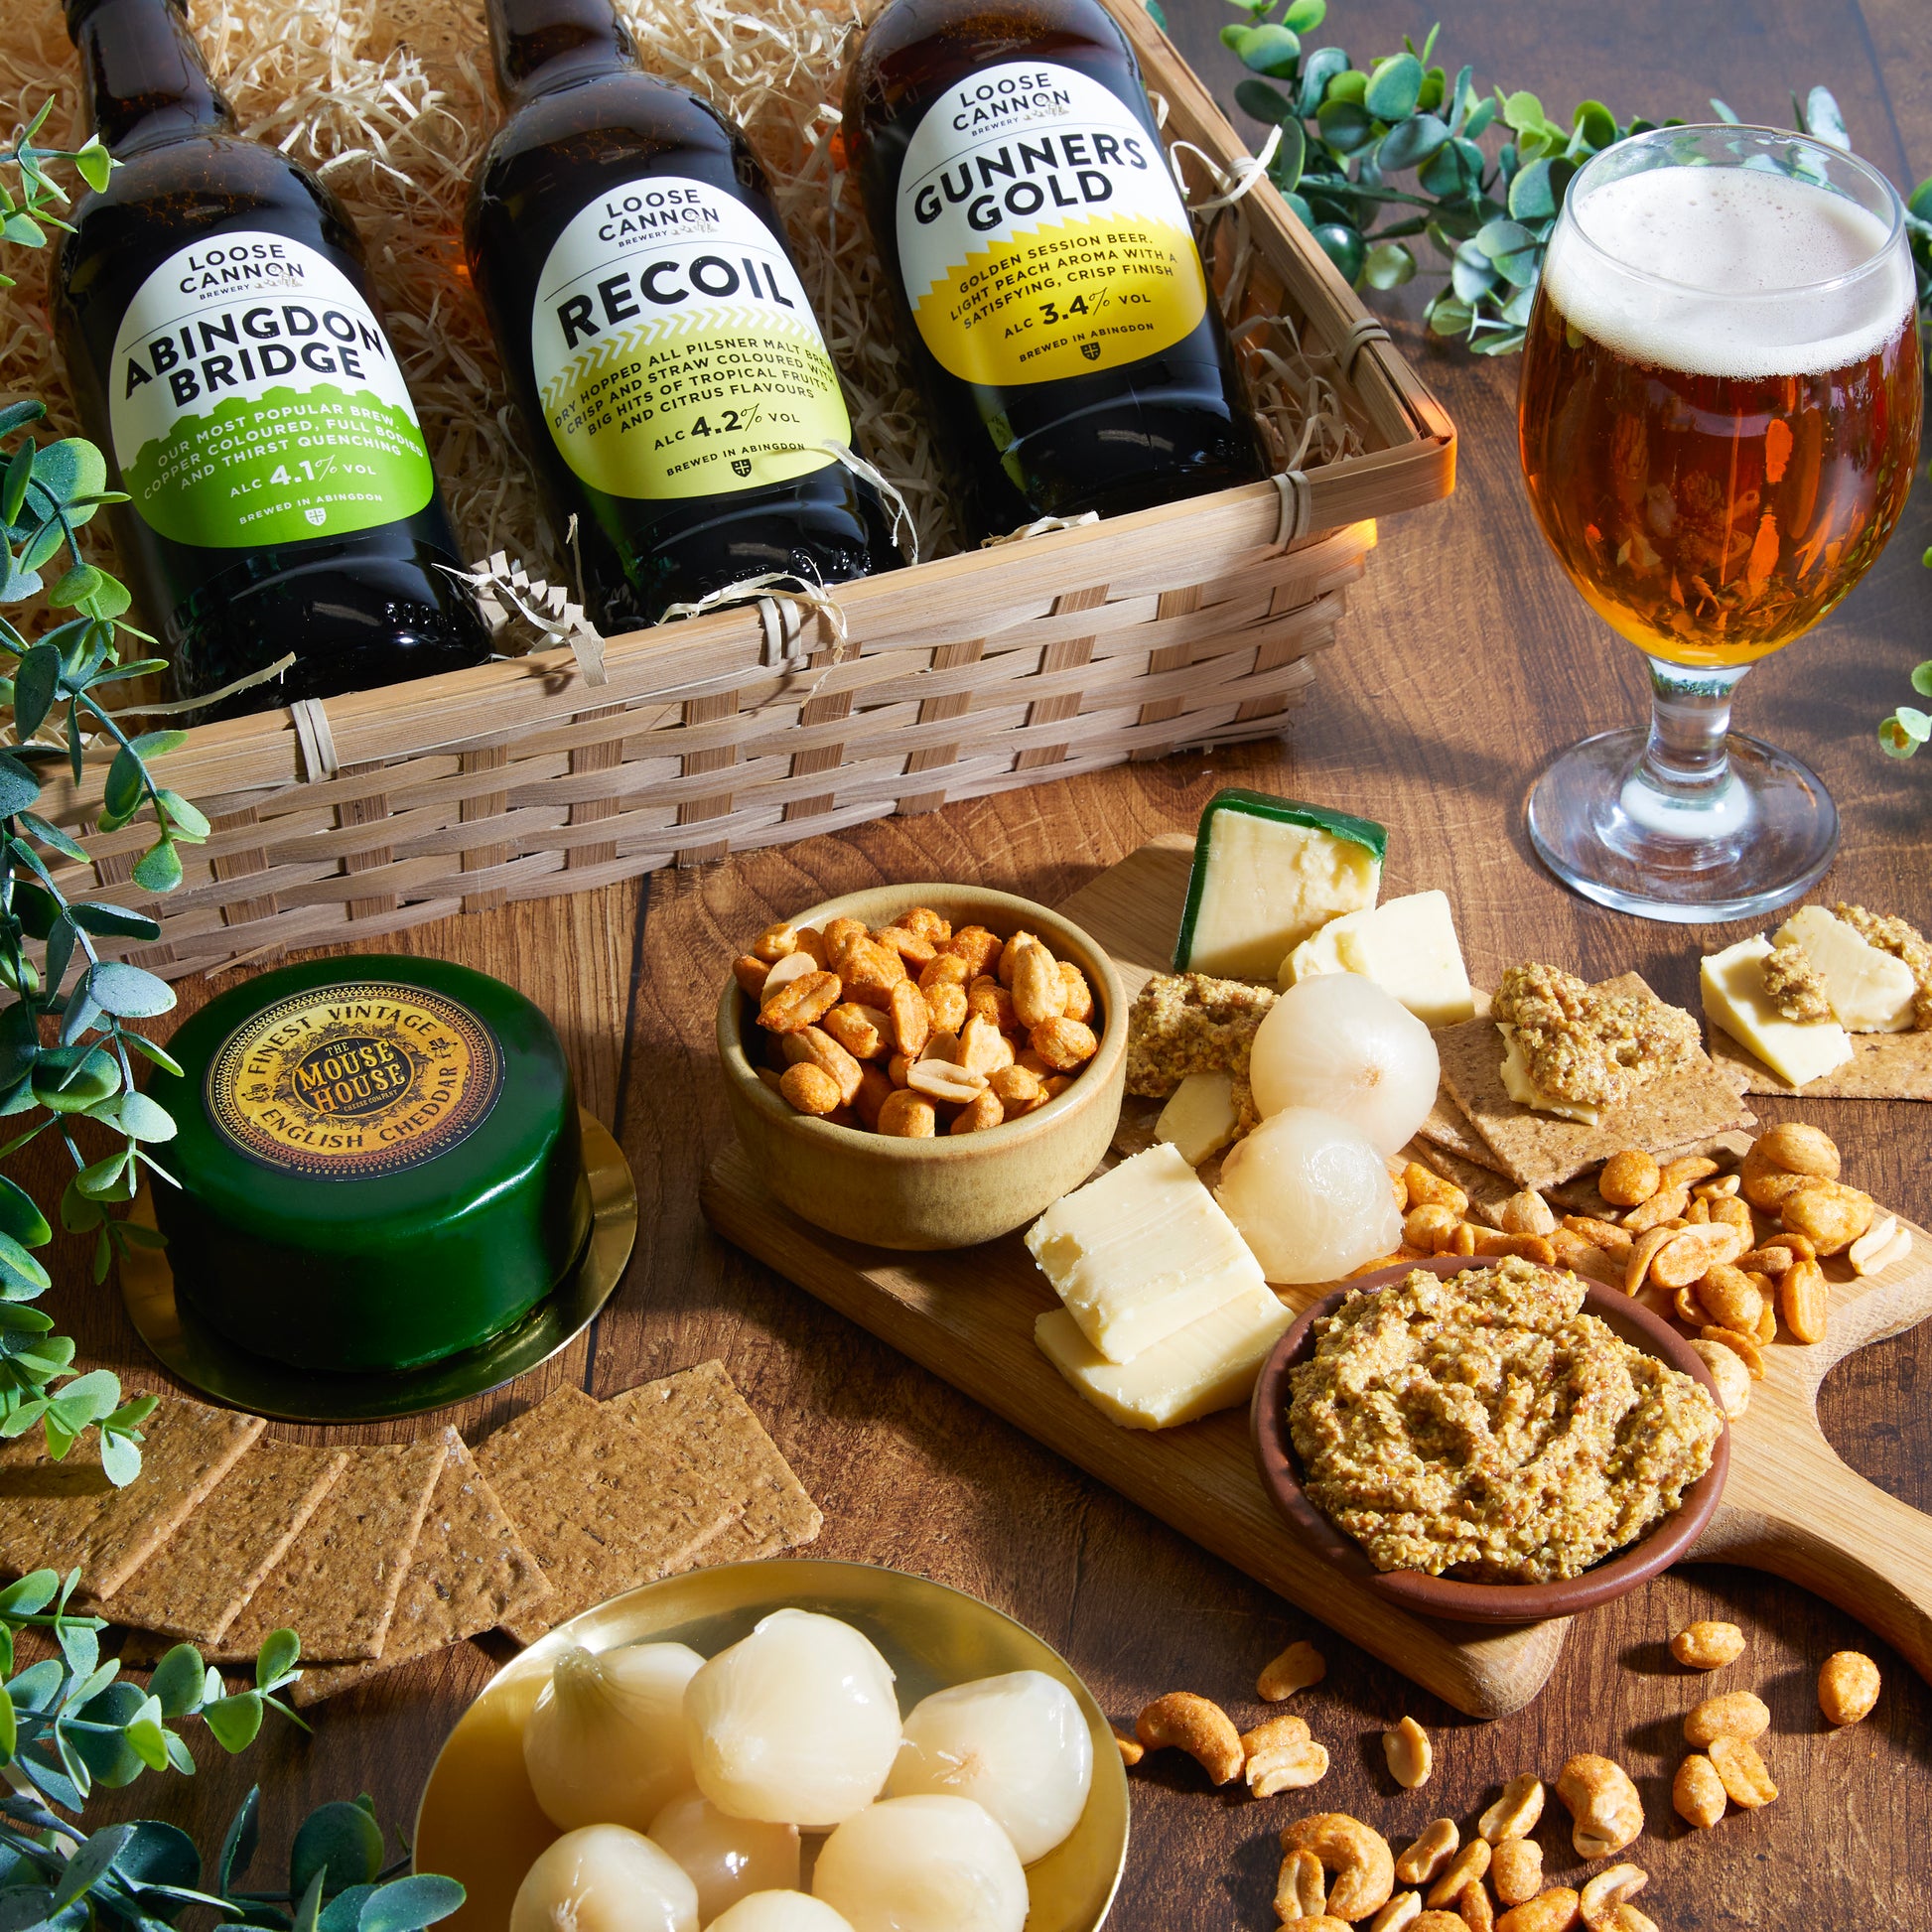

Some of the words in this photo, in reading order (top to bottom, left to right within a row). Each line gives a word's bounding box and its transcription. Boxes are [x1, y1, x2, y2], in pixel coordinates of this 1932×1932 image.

[953, 89, 1071, 131] CANNON
[960, 72, 1051, 108] LOOSE
[971, 117, 1019, 136] BREWERY
[607, 189, 701, 219] LOOSE
[914, 133, 1148, 224] GUNNERS
[967, 170, 1113, 231] GOLD
[598, 207, 721, 242] CANNON
[618, 229, 667, 247] BREWERY
[180, 262, 304, 294] CANNON
[189, 244, 287, 272] LOOSE
[959, 253, 1021, 294] GOLDEN
[1029, 234, 1100, 258] SESSION
[1108, 233, 1153, 245] BEER.
[200, 284, 249, 300] BREWERY
[557, 255, 794, 350] RECOIL
[949, 288, 989, 321] LIGHT
[996, 264, 1050, 292] PEACH
[1057, 249, 1118, 269] AROMA
[1125, 248, 1164, 262] WITH
[1170, 253, 1177, 263] A
[964, 278, 1061, 329] SATISFYING,
[1067, 265, 1116, 282] CRISP
[1123, 263, 1173, 276] FINISH
[1005, 318, 1034, 339] ALC
[1039, 287, 1110, 325] 3.4%
[1119, 292, 1152, 305] VOL
[126, 306, 386, 400] ABINGDON
[1019, 338, 1068, 362] BREWED
[1071, 333, 1085, 342] IN
[1090, 323, 1154, 339] ABINGDON
[169, 343, 366, 408] BRIDGE
[554, 400, 577, 429] DRY
[580, 361, 642, 402] HOPPED
[648, 348, 681, 367] ALL
[686, 338, 759, 355] PILSNER
[763, 339, 801, 354] MALT
[567, 402, 604, 434] CRISP
[609, 380, 643, 403] AND
[648, 357, 710, 383] STRAW
[717, 354, 803, 367] COLOURED
[809, 363, 835, 387] WITH
[588, 410, 613, 436] BIG
[618, 392, 654, 416] HITS
[661, 382, 683, 397] OF
[689, 367, 776, 387] TROPICAL
[783, 369, 828, 392] FRUITS
[620, 408, 656, 433] AND
[661, 388, 724, 413] CITRUS
[730, 384, 815, 399] FLAVOURS
[653, 430, 686, 450] ALC
[690, 403, 762, 438] 4.2%
[768, 413, 801, 423] VOL
[144, 452, 201, 500] COPPER
[207, 420, 320, 456] COLOURED,
[327, 419, 370, 433] FULL
[375, 427, 424, 458] BODIED
[158, 440, 190, 467] OUR
[197, 416, 245, 443] MOST
[255, 403, 344, 423] POPULAR
[349, 406, 400, 430] BREW.
[666, 454, 718, 477] BREWED
[723, 447, 737, 458] IN
[742, 442, 806, 455] ABINGDON
[181, 463, 215, 490] AND
[221, 439, 290, 468] THIRST
[298, 436, 401, 457] QUENCHING
[230, 479, 263, 498] ALC
[269, 455, 339, 486] 4.1%
[343, 464, 377, 476] VOL
[239, 501, 292, 525] BREWED
[297, 497, 312, 506] IN
[316, 493, 382, 503] ABINGDON
[248, 1016, 313, 1075] FINEST
[328, 1005, 437, 1037] VINTAGE
[295, 1040, 397, 1092] MOUSE
[326, 1041, 349, 1056] THE
[261, 1108, 363, 1148] ENGLISH
[379, 1066, 458, 1143] CHEDDAR
[312, 1063, 407, 1116] HOUSE
[344, 1100, 367, 1113] CHEESE
[368, 1089, 398, 1106] COMPANY
